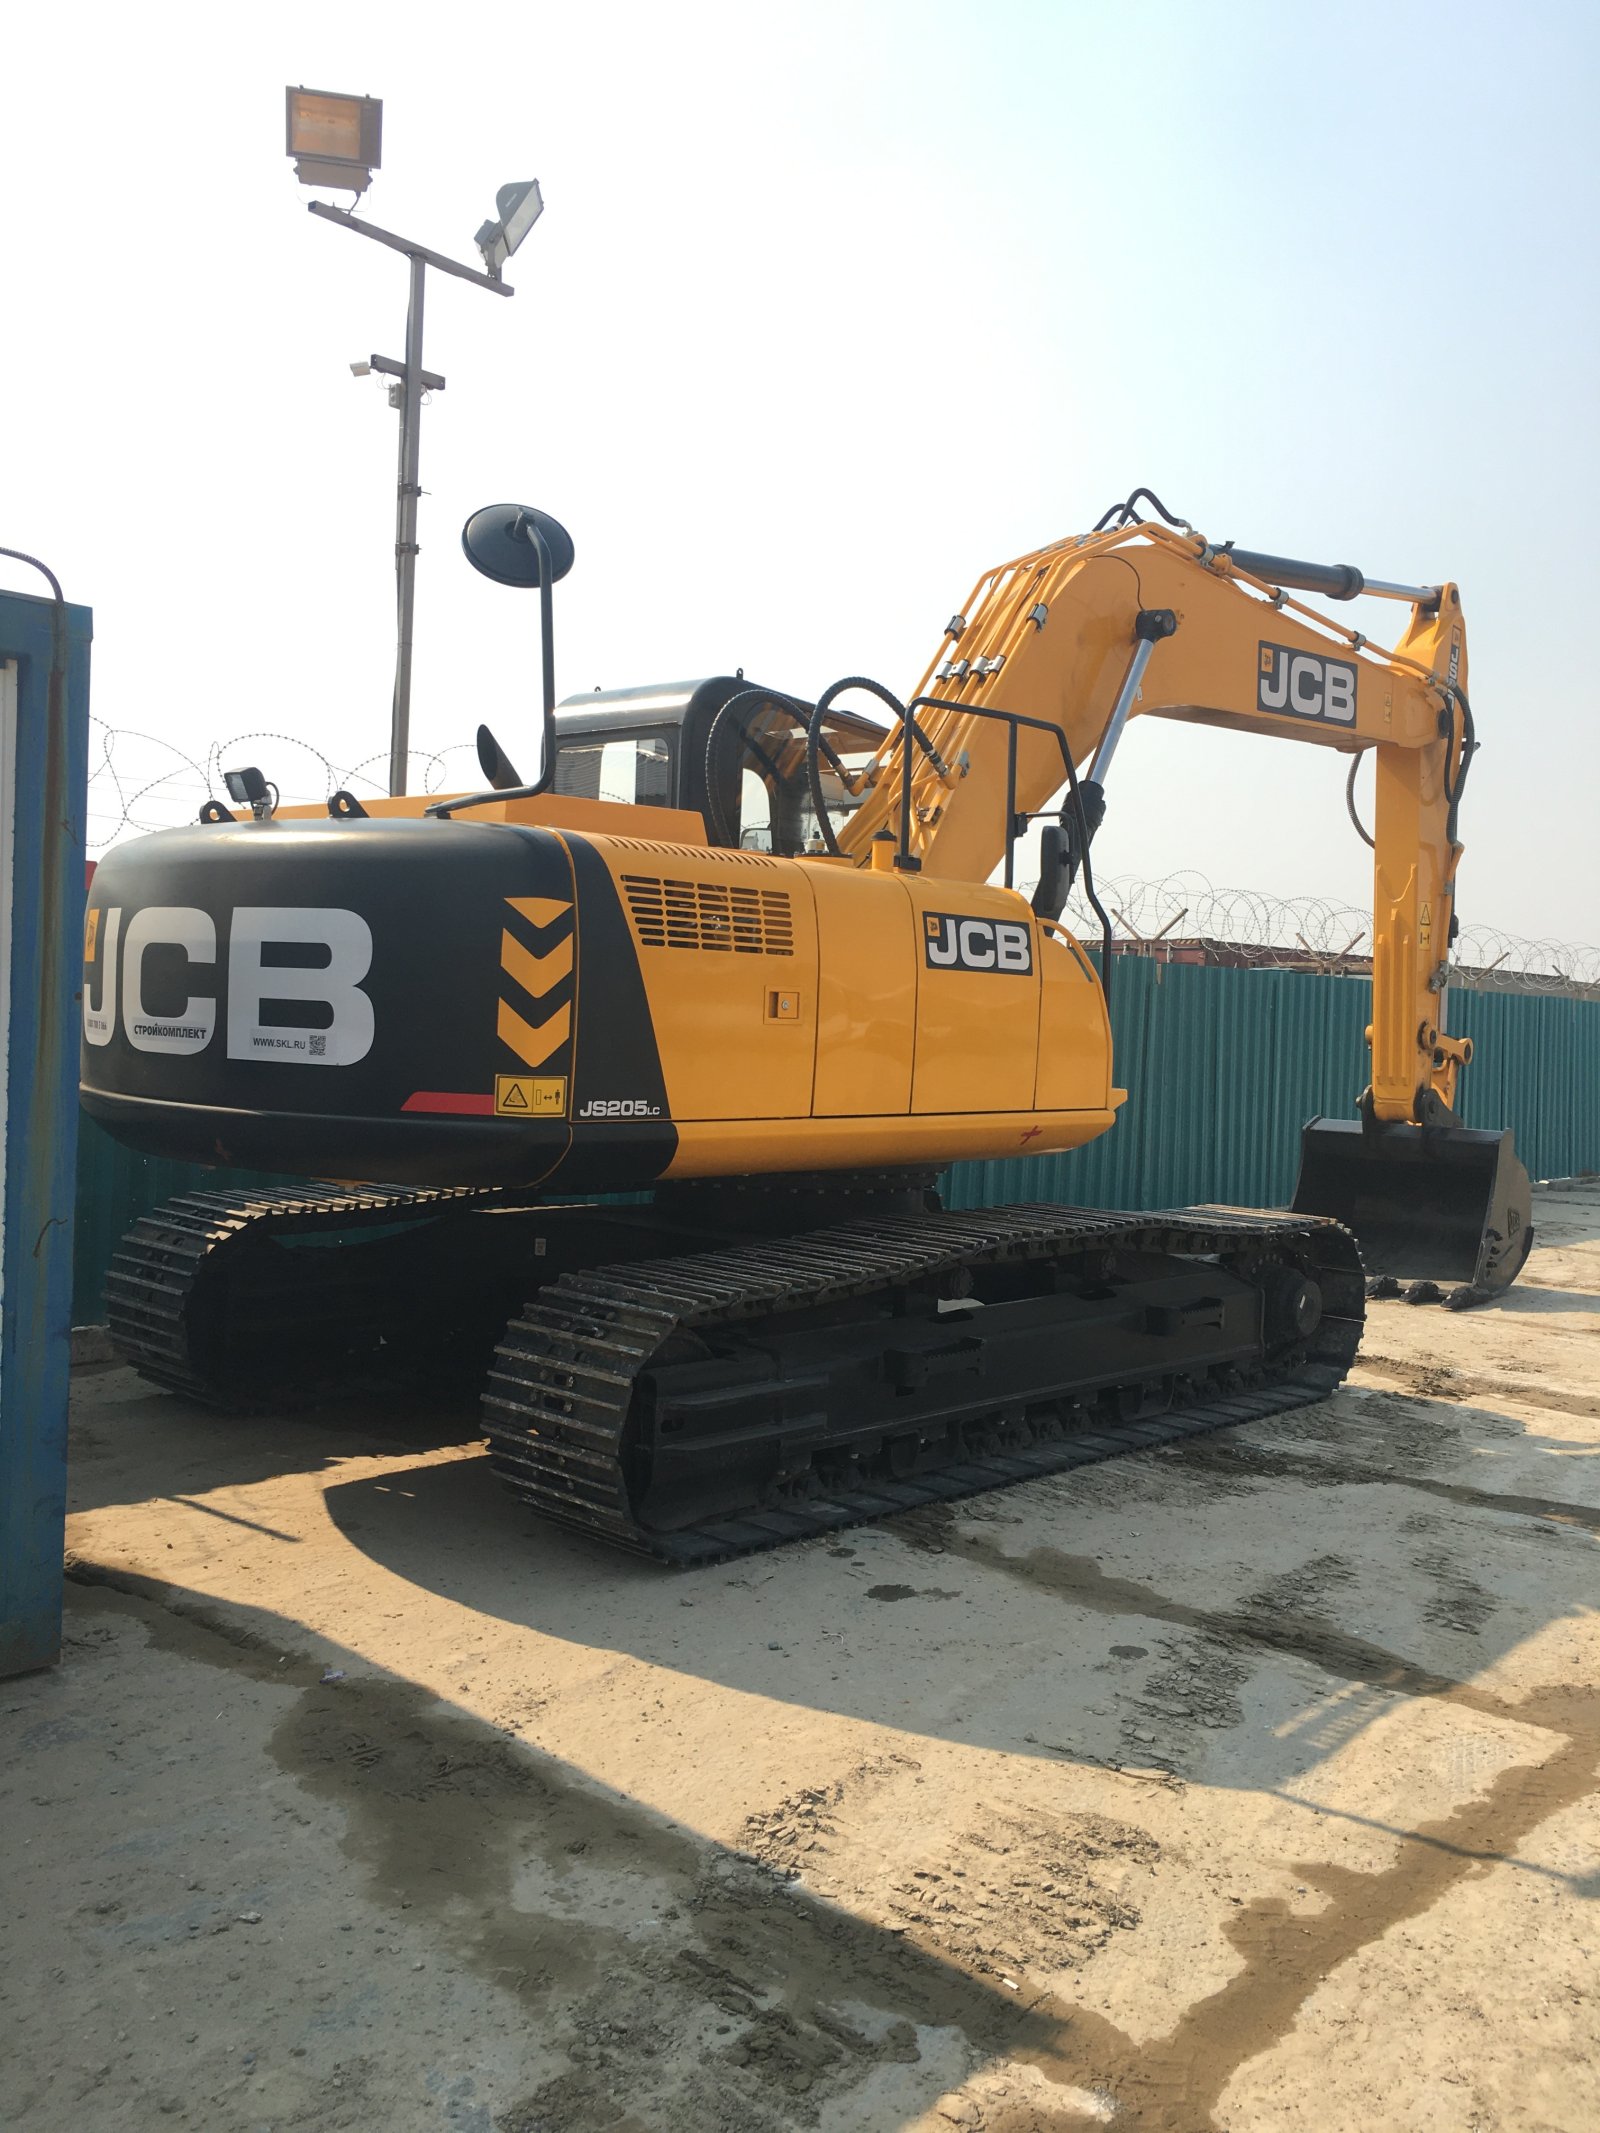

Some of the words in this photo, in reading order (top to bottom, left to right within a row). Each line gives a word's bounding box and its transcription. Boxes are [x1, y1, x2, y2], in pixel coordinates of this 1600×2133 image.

[1260, 651, 1355, 721] JCB
[928, 918, 1030, 971] JCB
[83, 906, 375, 1067] JCB
[134, 1022, 207, 1039] СТРОЙКОМПЛЕКТ
[253, 1037, 306, 1050] WWW.SKL.RU
